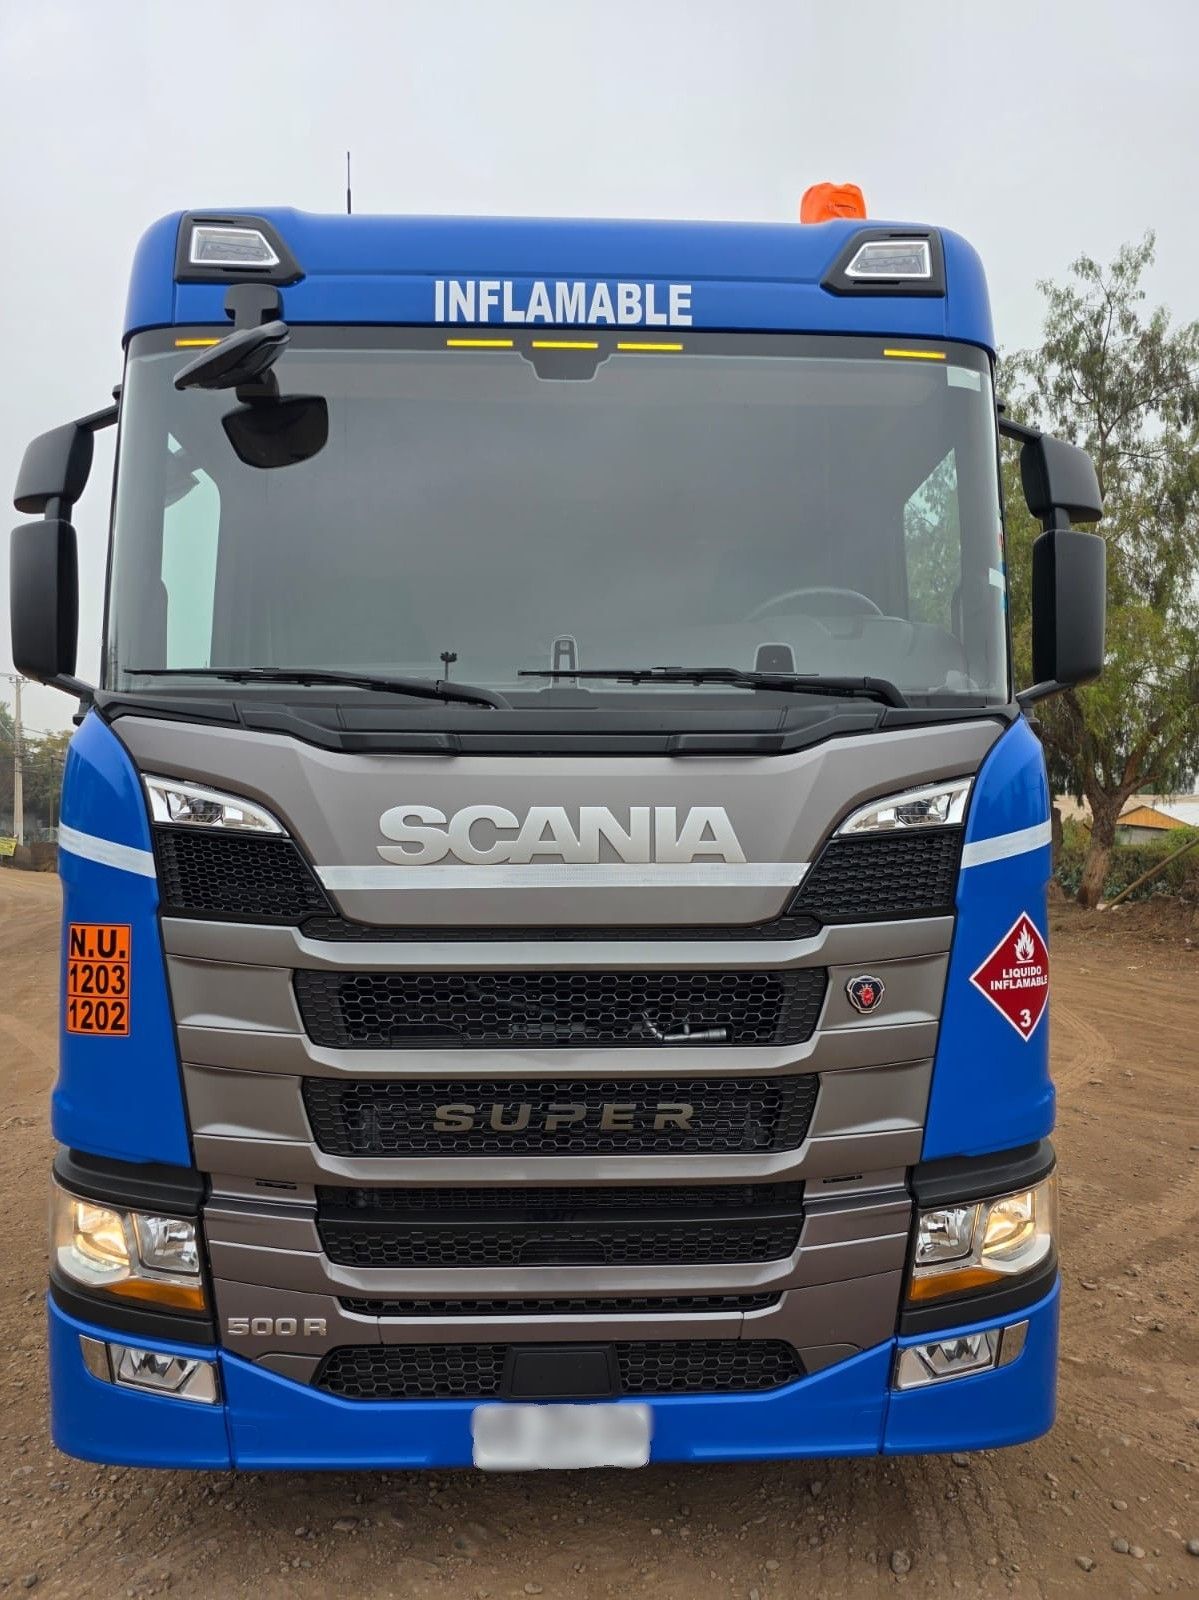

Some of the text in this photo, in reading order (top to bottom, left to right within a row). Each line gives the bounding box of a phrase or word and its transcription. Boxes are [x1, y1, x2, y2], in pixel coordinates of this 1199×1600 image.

[434, 280, 692, 326] INFLAMABLE
[376, 804, 748, 866] SCANIA
[70, 927, 126, 958] N.U.
[69, 963, 126, 994] 1203
[990, 975, 1048, 990] INFLAMABLE
[1002, 966, 1041, 978] LIQUIDO
[69, 999, 126, 1031] 1202
[1019, 1008, 1032, 1028] 3
[433, 1103, 694, 1132] SUPER
[227, 1317, 327, 1336] 500 R
